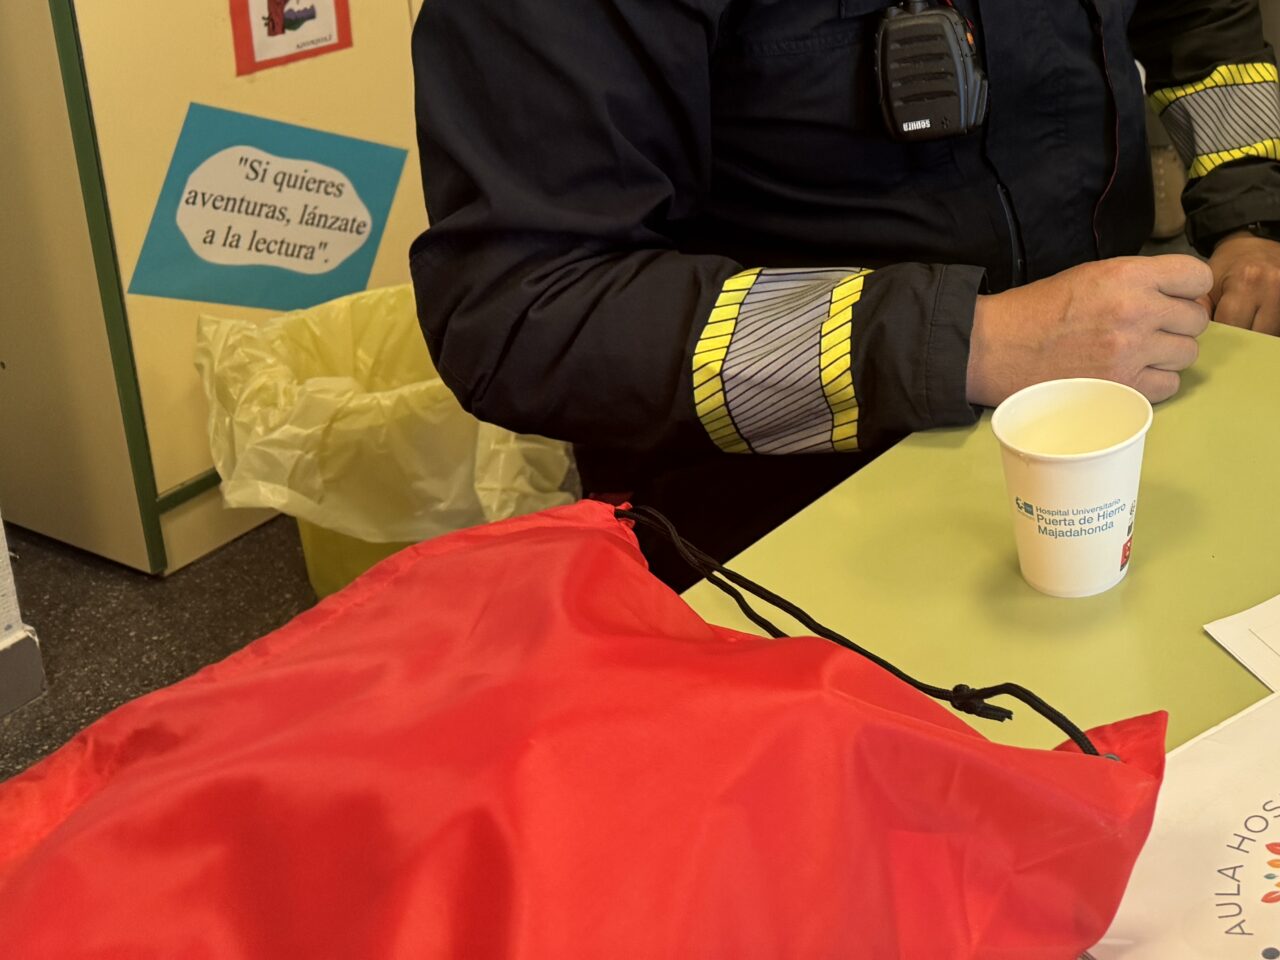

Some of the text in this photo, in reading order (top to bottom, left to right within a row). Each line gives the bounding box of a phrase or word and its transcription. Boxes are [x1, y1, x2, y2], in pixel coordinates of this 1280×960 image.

[238, 156, 345, 199] "Si quieres
[184, 188, 367, 236] aventuras, lánzate
[202, 228, 216, 246] a
[222, 225, 241, 249] la
[1035, 505, 1070, 517] Hospital
[1071, 498, 1121, 515] Universitario
[1036, 513, 1076, 527] Puerta
[1078, 515, 1094, 526] de
[1097, 503, 1126, 523] Hierro
[1037, 520, 1115, 539] Majadahonda
[1214, 863, 1255, 937] AULA
